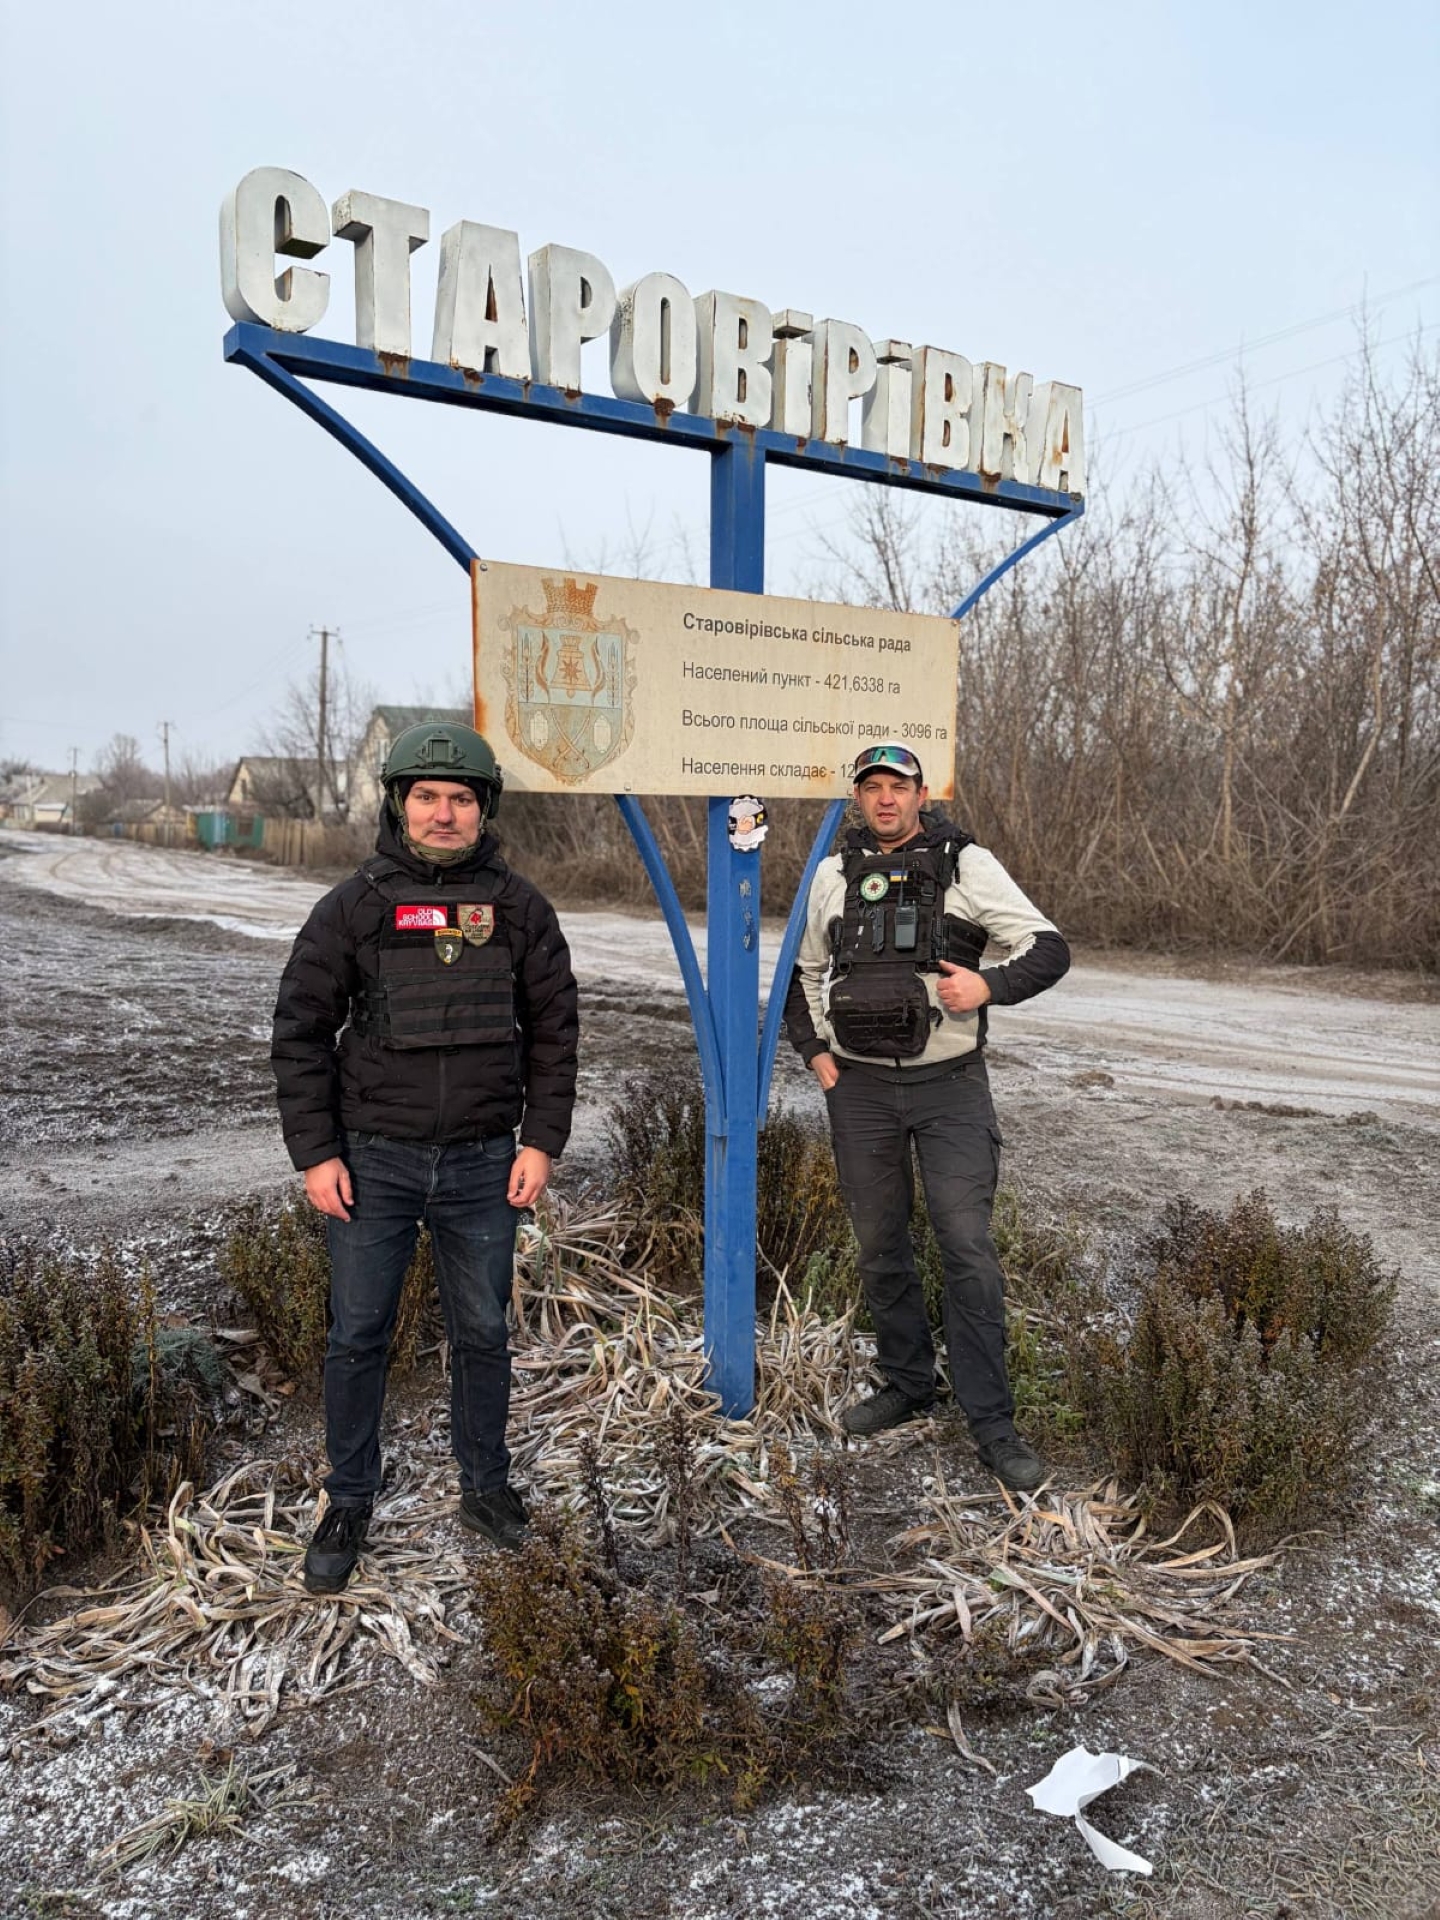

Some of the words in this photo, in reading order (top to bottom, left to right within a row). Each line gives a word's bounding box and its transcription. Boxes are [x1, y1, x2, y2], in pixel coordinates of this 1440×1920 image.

[683, 612, 808, 642] Старовірівська
[812, 627, 875, 649] сільська
[878, 636, 911, 653] рада
[682, 661, 768, 685] Населений
[771, 671, 812, 690] пункт
[824, 672, 884, 694] 421,6338
[888, 682, 901, 694] га
[682, 709, 735, 730] Всього
[740, 717, 788, 734] площа
[793, 716, 855, 735] сільської
[858, 724, 890, 739] ради
[901, 722, 932, 739] 3096
[936, 728, 948, 740] га
[682, 757, 765, 777] Населення
[770, 762, 827, 779] складає
[841, 763, 855, 778] 12
